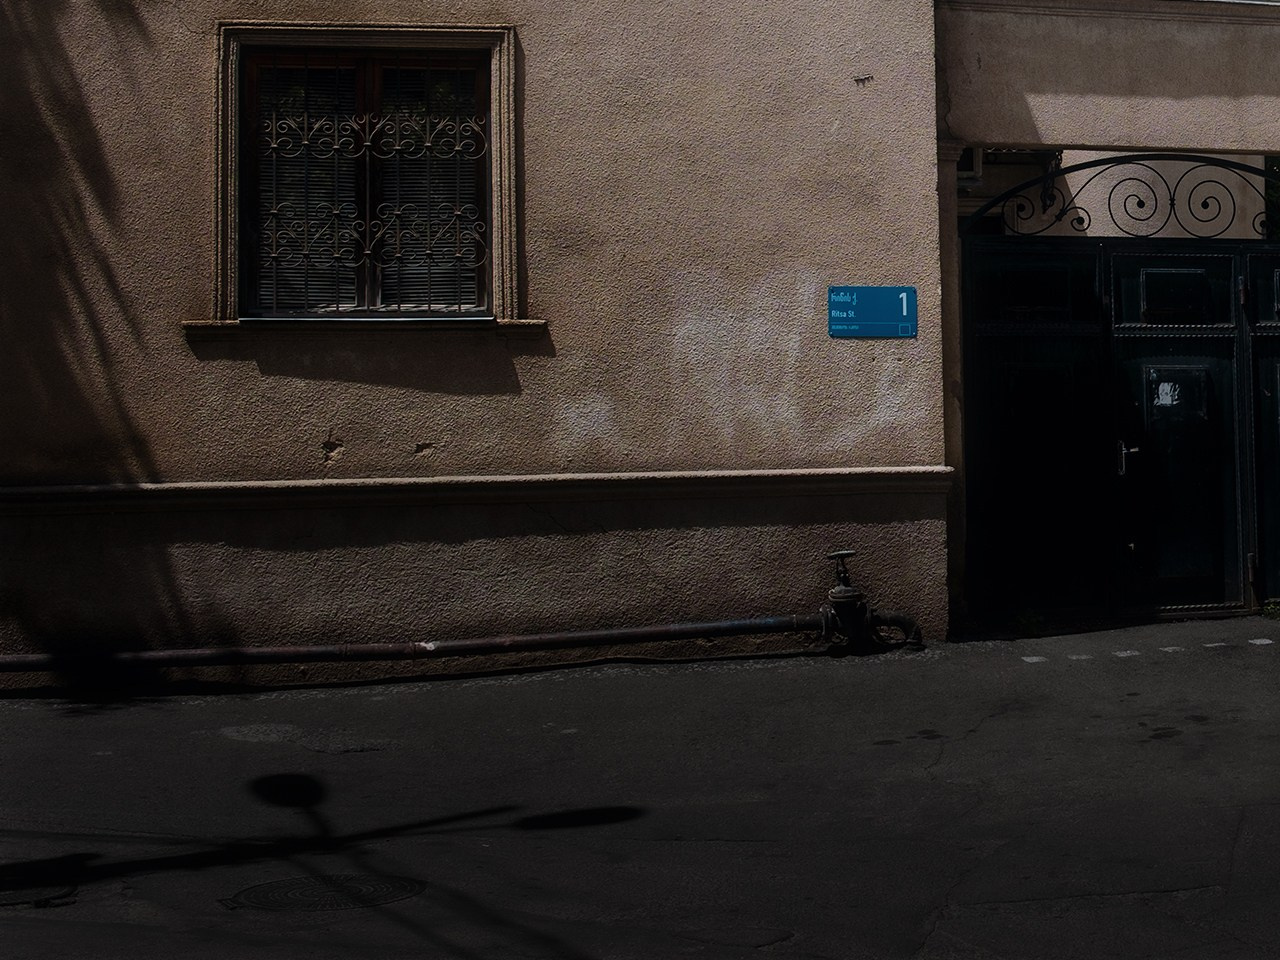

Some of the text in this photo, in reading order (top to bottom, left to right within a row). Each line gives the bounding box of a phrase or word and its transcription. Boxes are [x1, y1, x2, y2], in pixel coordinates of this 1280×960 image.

[899, 292, 907, 316] 1
[831, 310, 857, 318] Ritsa St.
